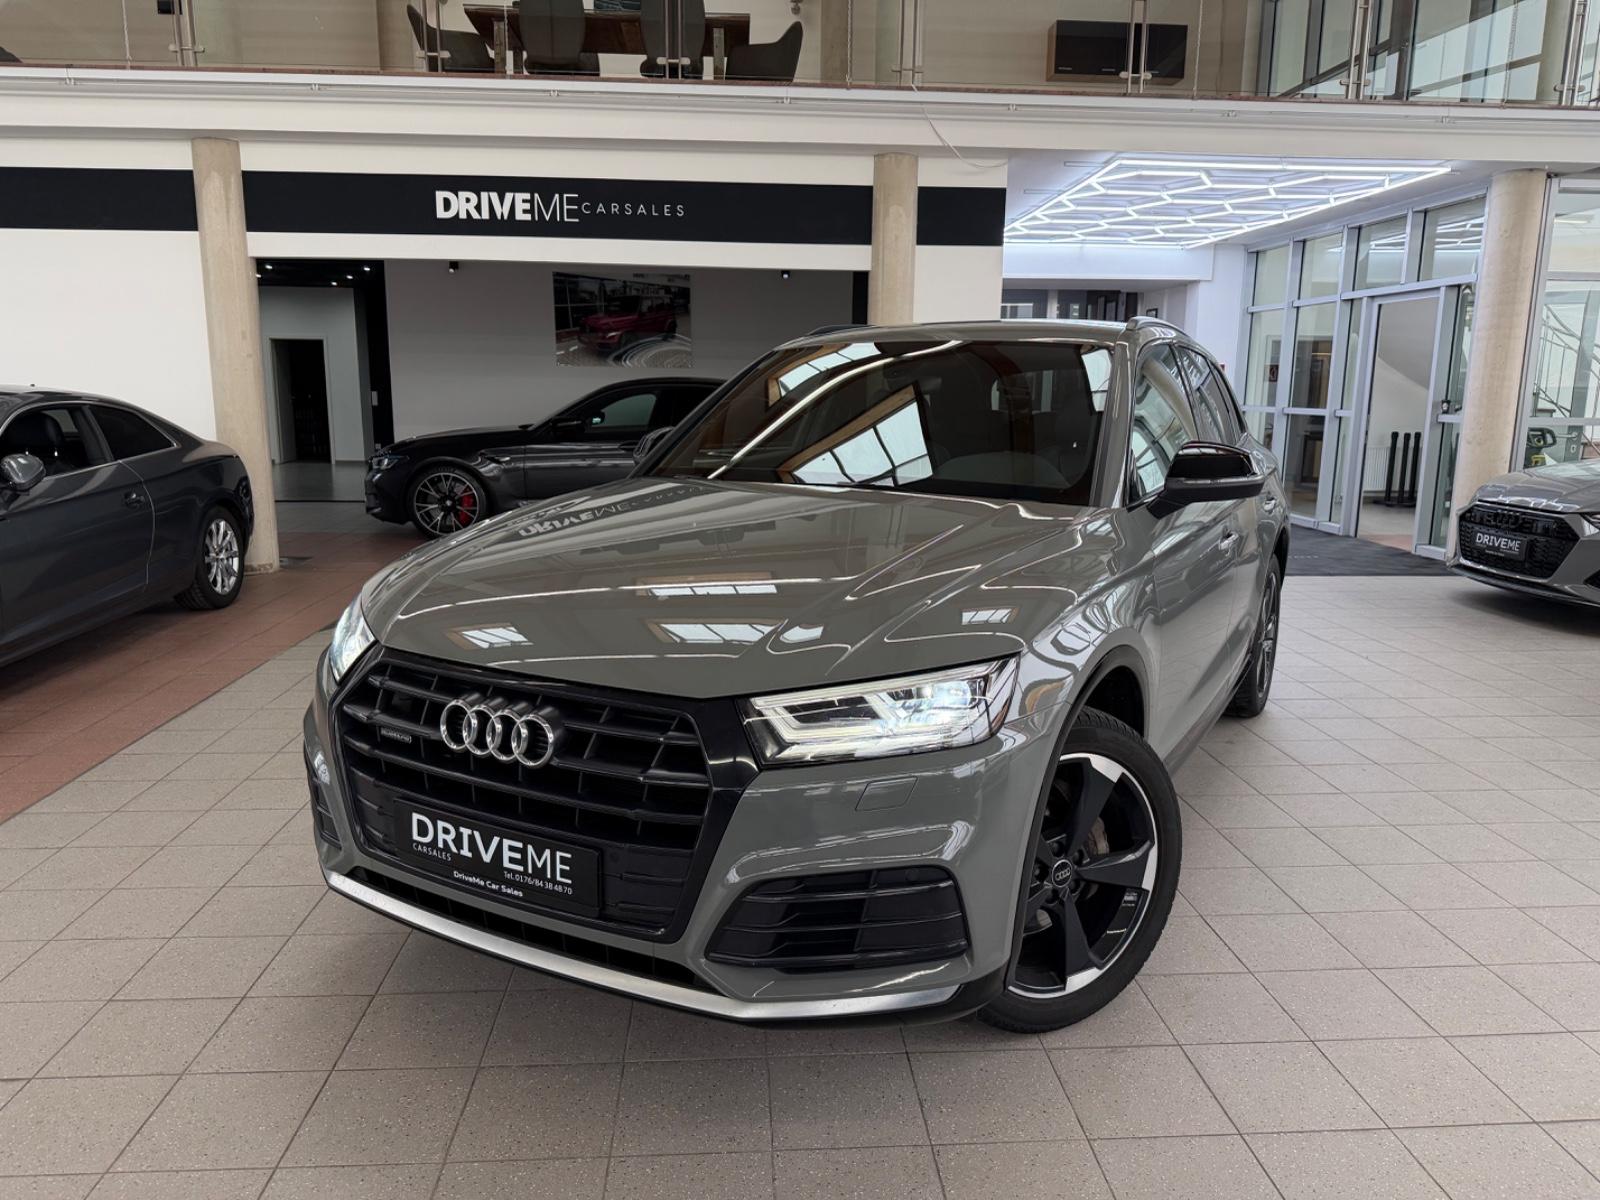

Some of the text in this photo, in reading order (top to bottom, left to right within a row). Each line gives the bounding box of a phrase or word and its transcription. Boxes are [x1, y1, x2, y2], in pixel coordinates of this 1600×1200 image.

[435, 190, 685, 222] DRIVEME CARSALES
[1476, 532, 1521, 552] DRIVEME
[411, 812, 572, 884] DRIVEME
[412, 842, 452, 862] CARSALES
[453, 870, 523, 897] DriveMe Car Sales
